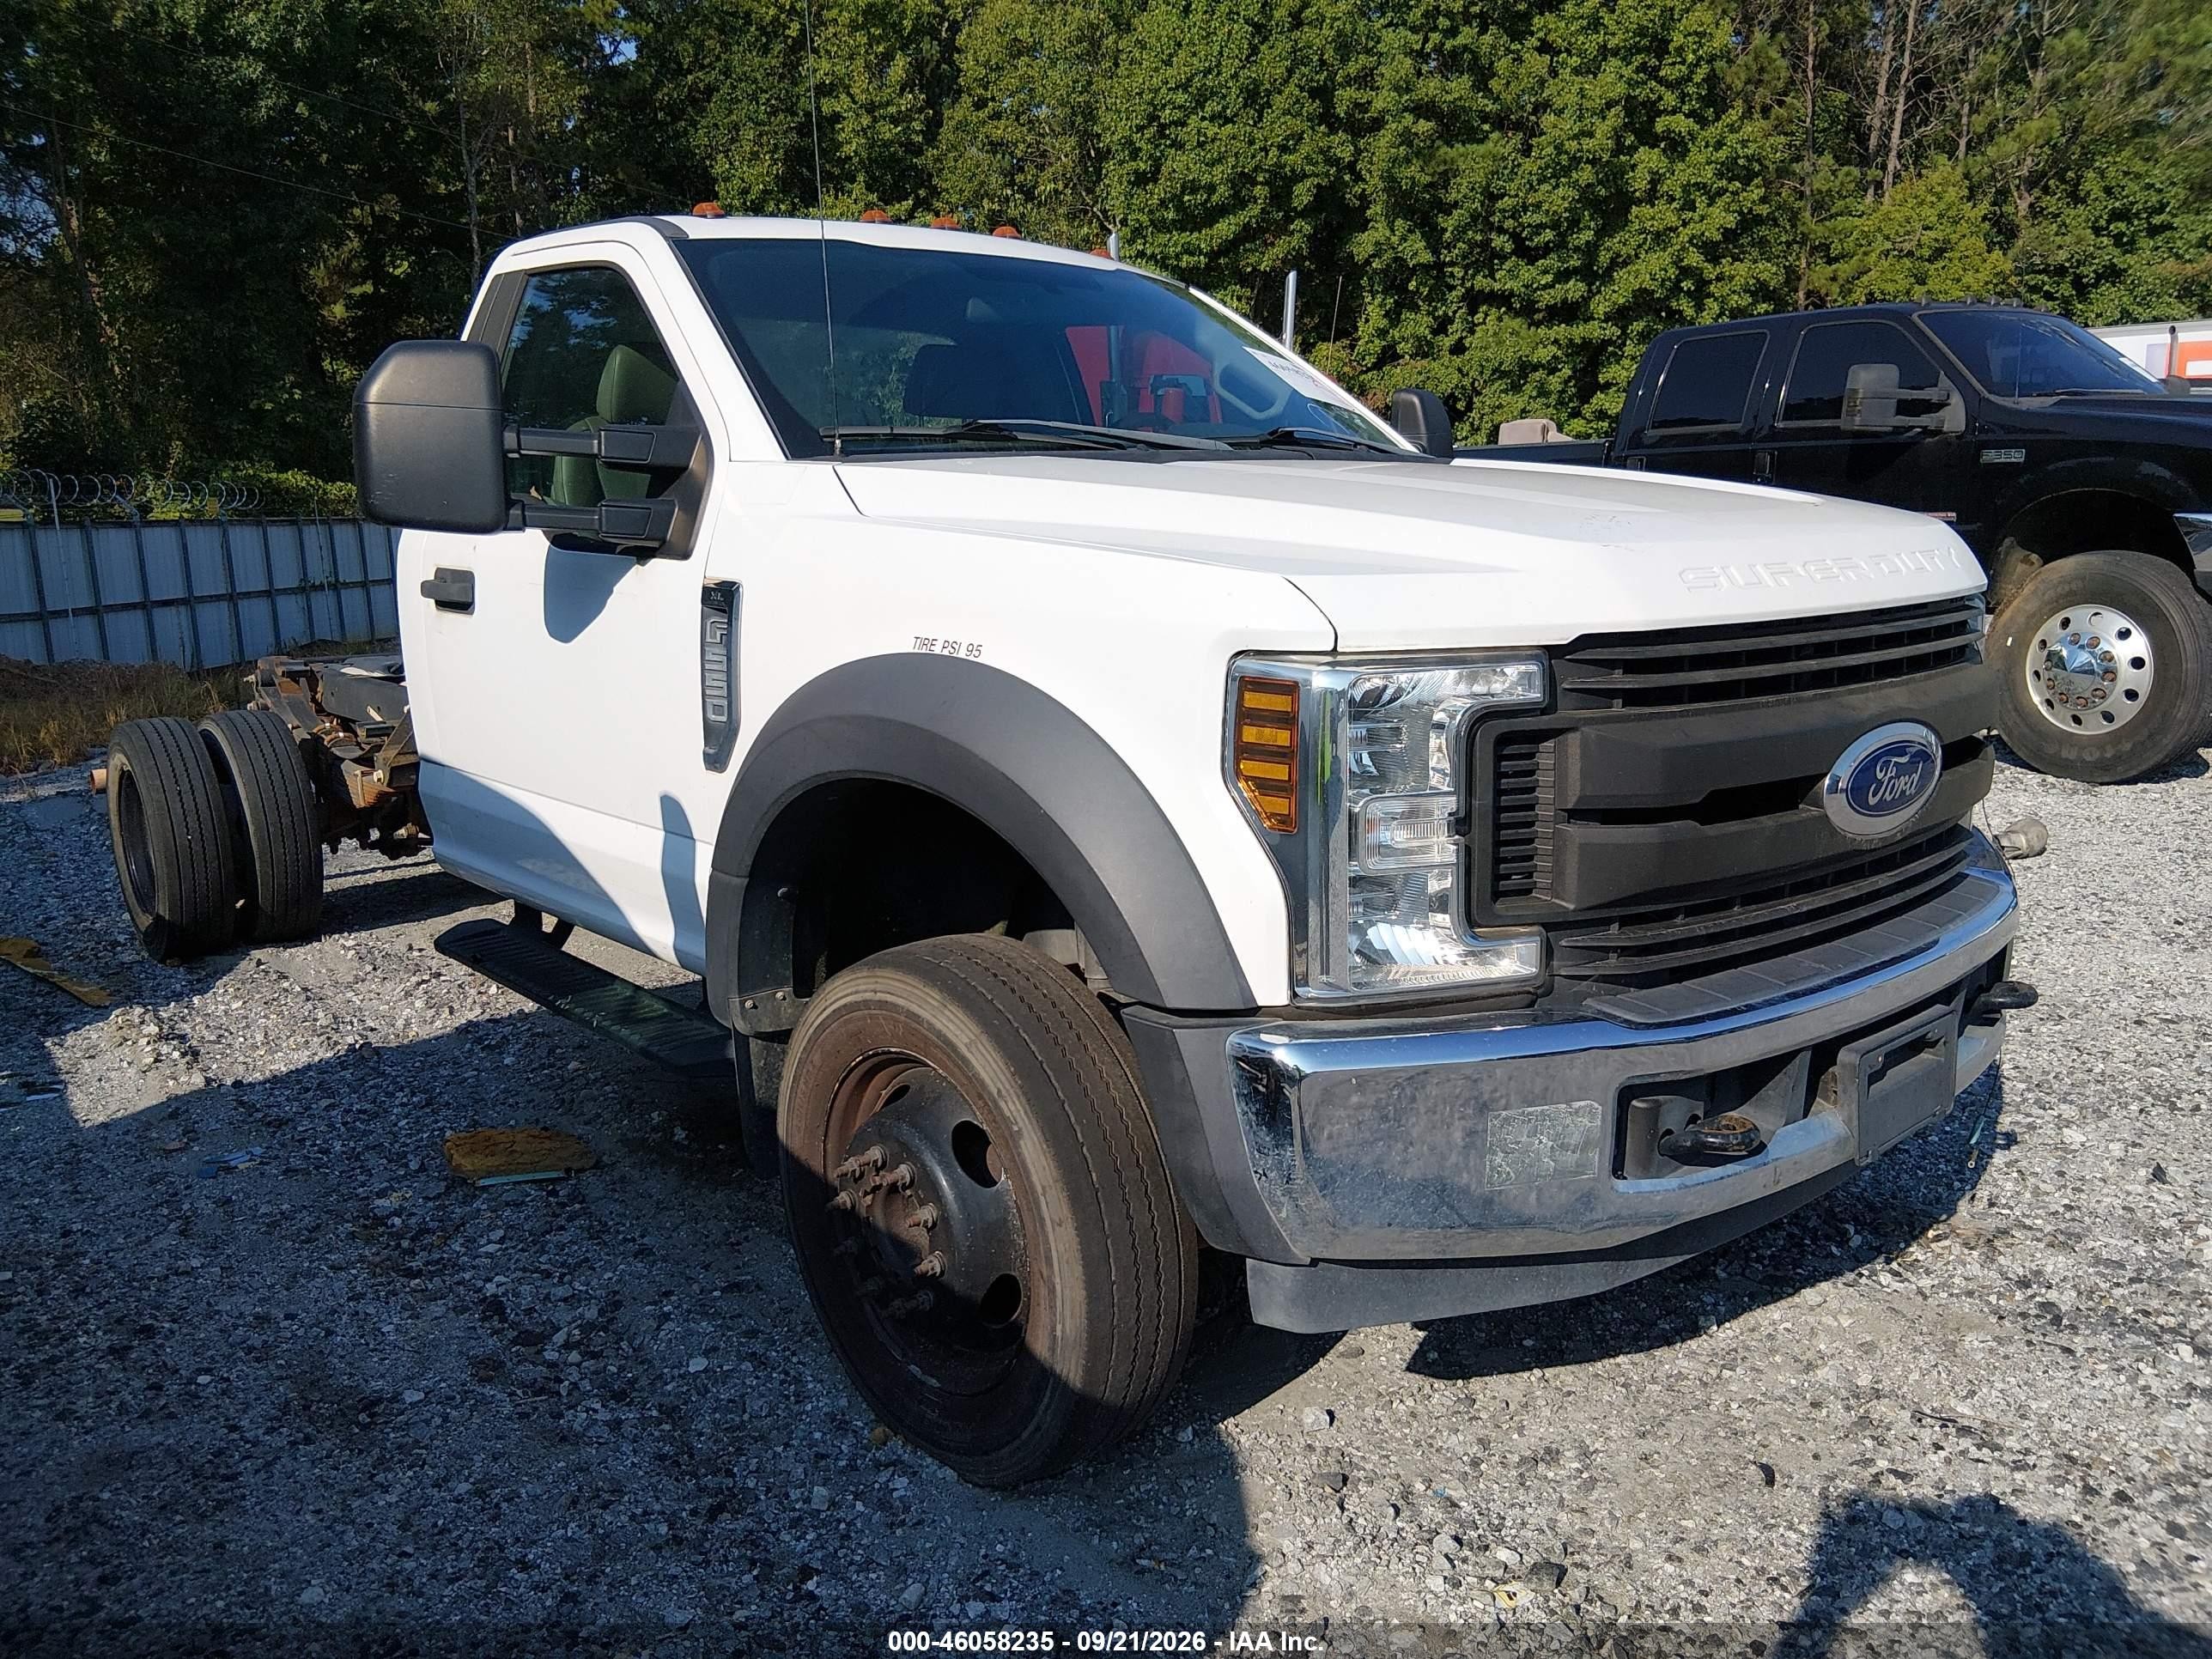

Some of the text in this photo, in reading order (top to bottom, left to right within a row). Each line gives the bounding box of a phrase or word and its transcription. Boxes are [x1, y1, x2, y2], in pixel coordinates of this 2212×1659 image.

[1678, 545, 1961, 592] SUPER DUTY
[710, 591, 724, 601] XL
[913, 636, 982, 658] TIRE PSI 95
[1869, 746, 1923, 805] Ford
